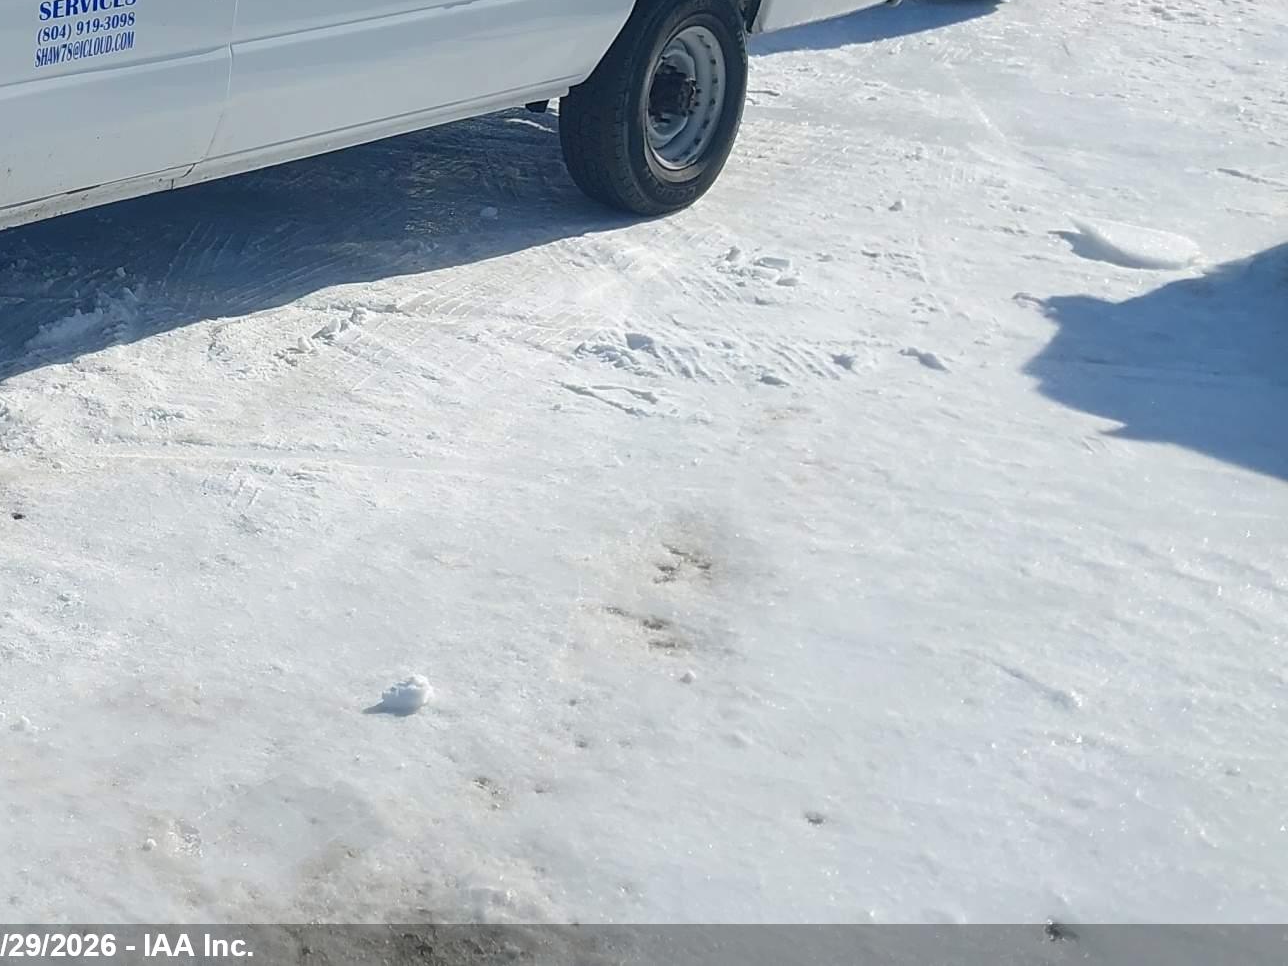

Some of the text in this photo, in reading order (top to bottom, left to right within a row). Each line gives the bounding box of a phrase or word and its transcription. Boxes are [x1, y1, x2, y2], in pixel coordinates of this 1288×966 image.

[37, 11, 135, 46] (804) 919-3098
[34, 31, 136, 68] SHAW78@ICLOUD.COM
